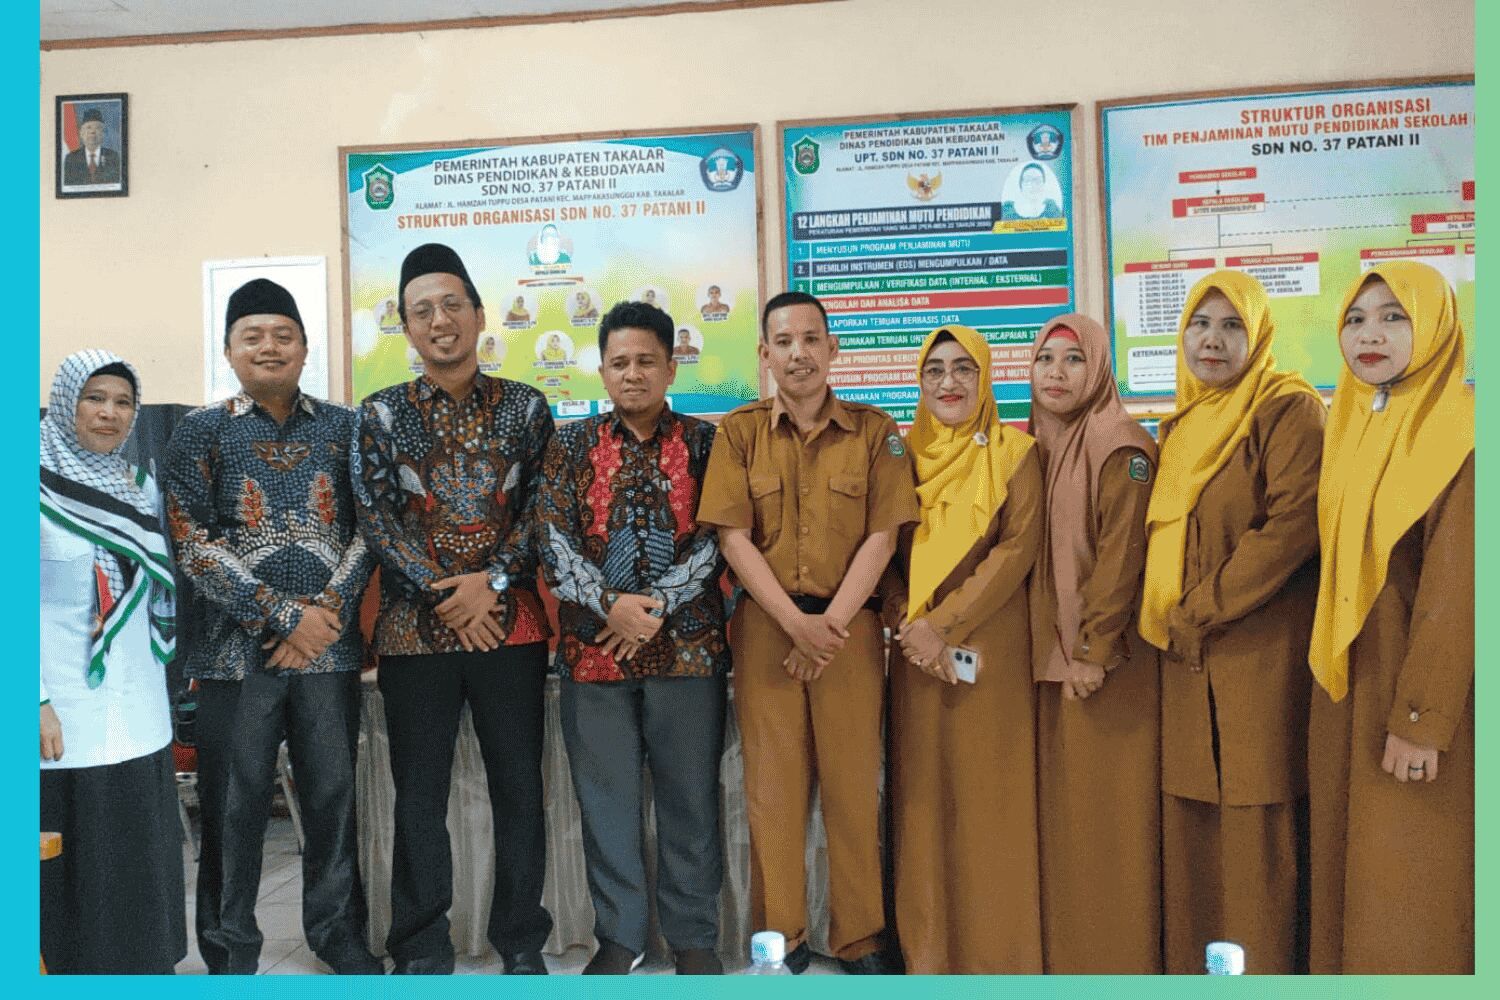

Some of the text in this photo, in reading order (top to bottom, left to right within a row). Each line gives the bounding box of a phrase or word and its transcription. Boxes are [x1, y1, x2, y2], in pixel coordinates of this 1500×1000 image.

[1241, 98, 1430, 124] STRUKTUR ORGANISASI
[844, 123, 1000, 140] PEMERINTAH KABUPATEN TAKALAR
[1143, 113, 1468, 146] TIM PENJAMINAN MUTU PENDIDIKAN SEKOLAH
[840, 133, 1005, 150] DINAS PENDIDIKAN DAN KEBUDAYAAN
[1251, 133, 1420, 156] SDN NO. 37 PATANI II
[434, 149, 664, 172] PEMERINTAH KABUPATEN TAKALAR
[854, 145, 999, 163] UPT. SDN NO. 37 PATANI II
[434, 162, 665, 186] DINAS PENDIDIKAN & KEBUDAYAAN
[482, 178, 616, 196] SDN NO. 37 PATANI II
[397, 200, 705, 229] STRUKTUR ORGANISASI SDN NO. 37 PATANI II
[809, 213, 850, 228] LANGKAH
[909, 208, 935, 223] MUTU
[936, 206, 992, 221] PENDIDIKAN
[989, 256, 1008, 266] DATA
[821, 299, 858, 309] ENGOLAH
